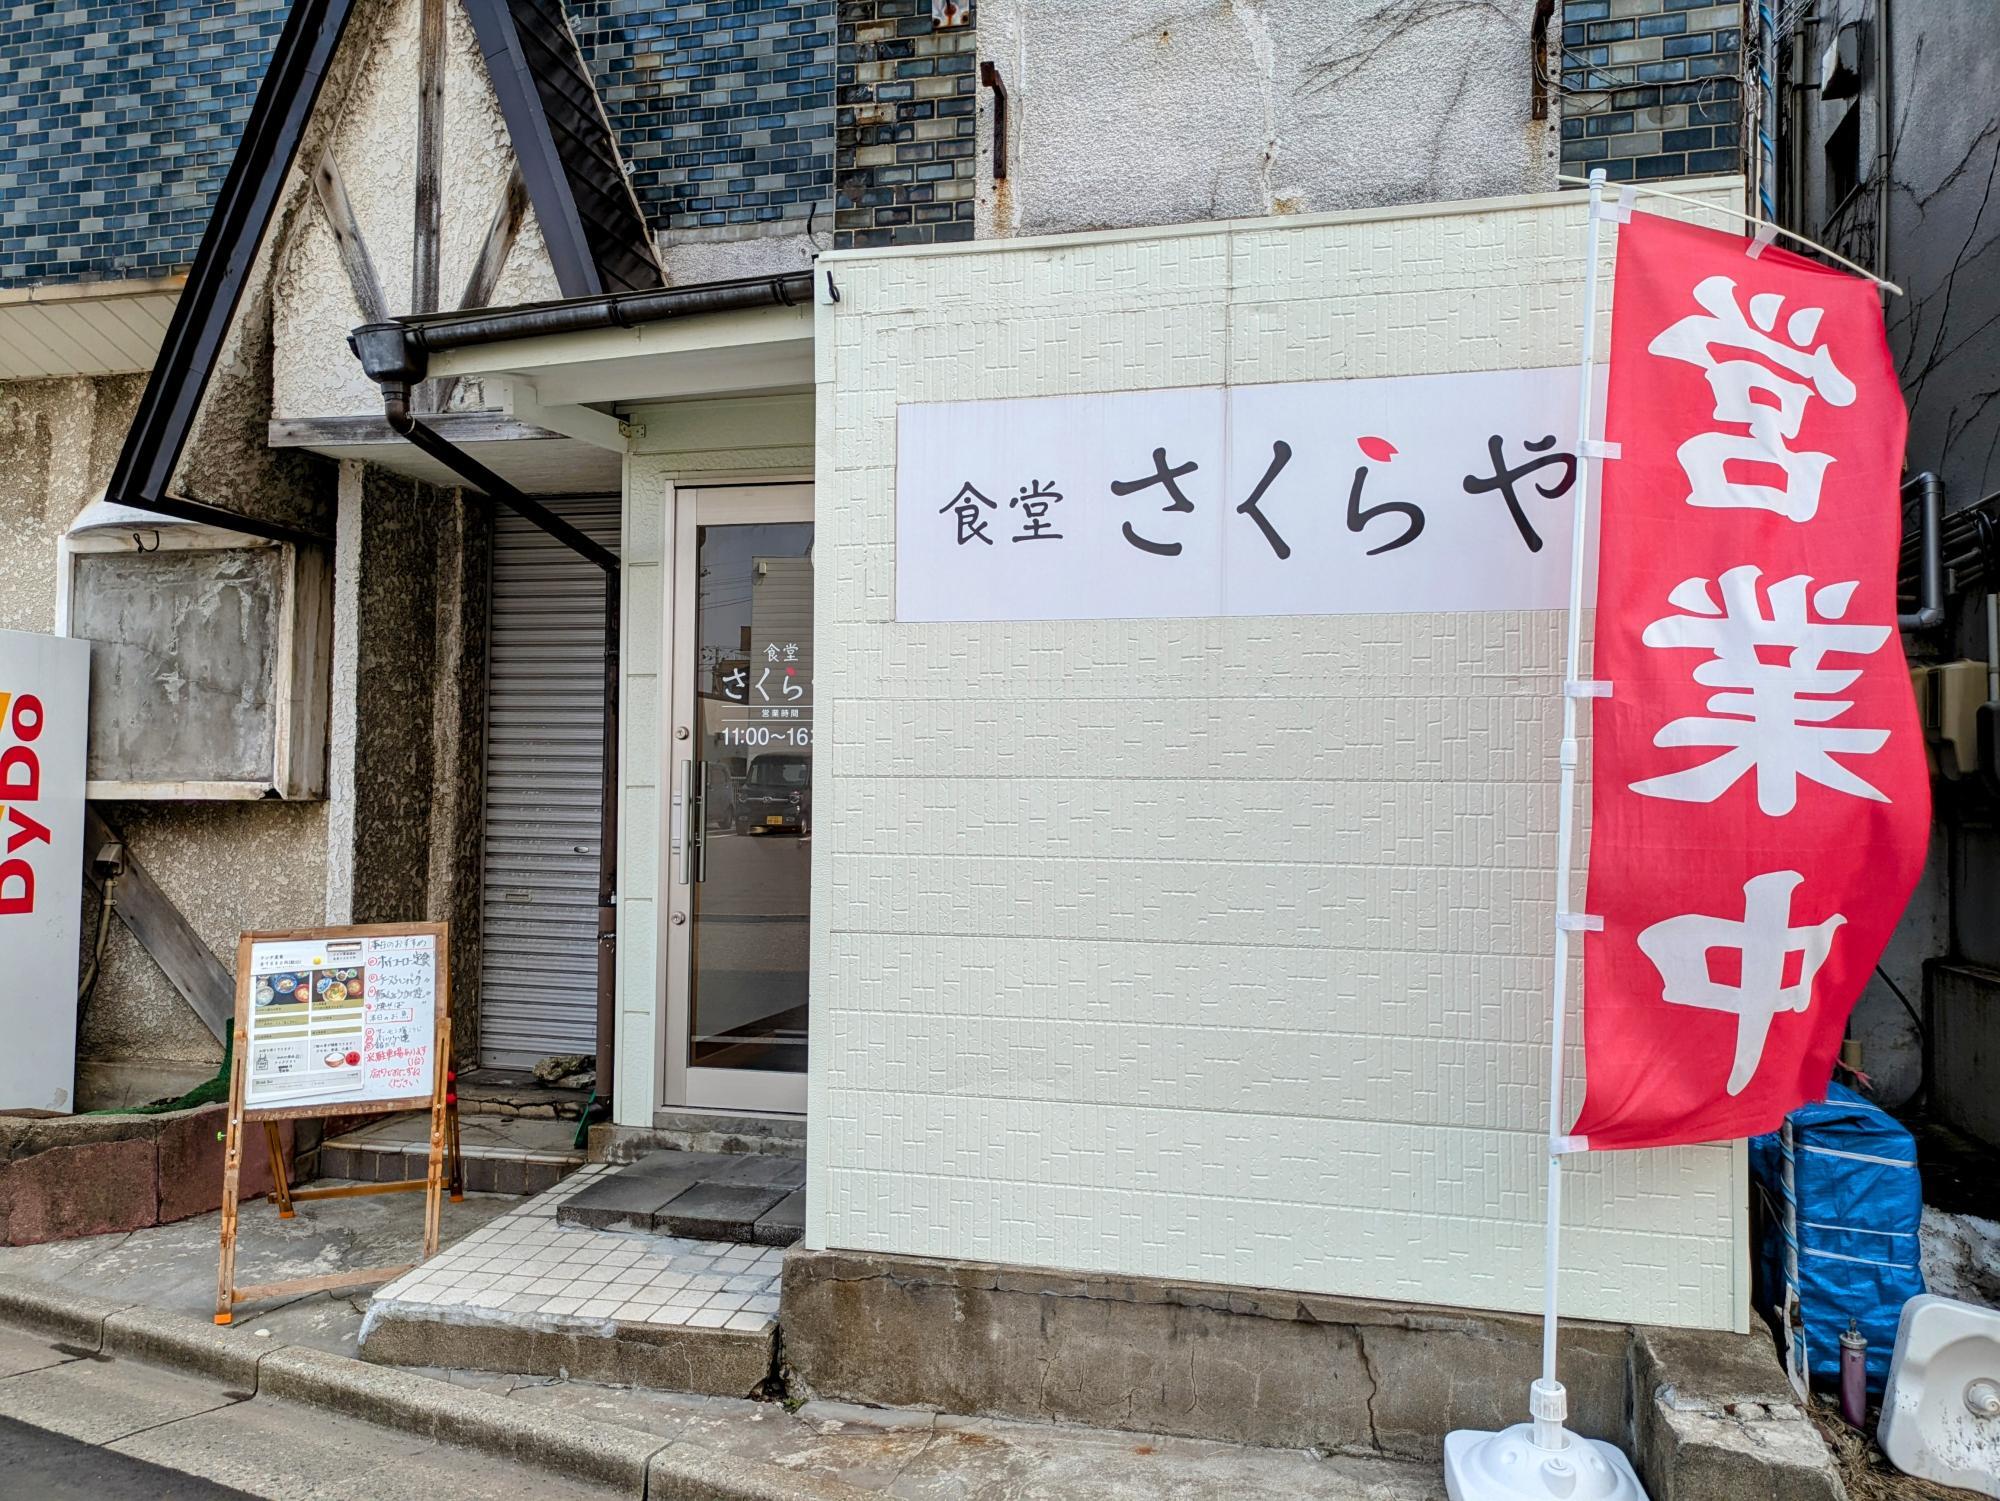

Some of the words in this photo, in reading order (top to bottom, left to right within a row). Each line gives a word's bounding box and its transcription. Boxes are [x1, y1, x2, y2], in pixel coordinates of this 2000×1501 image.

[939, 479, 1064, 546] 食堂
[1110, 435, 1577, 560] さくらや
[761, 709, 799, 718] 営業時間
[763, 642, 799, 662] 食堂
[1628, 275, 1893, 1098] 営業中
[0, 694, 51, 915] DyDo
